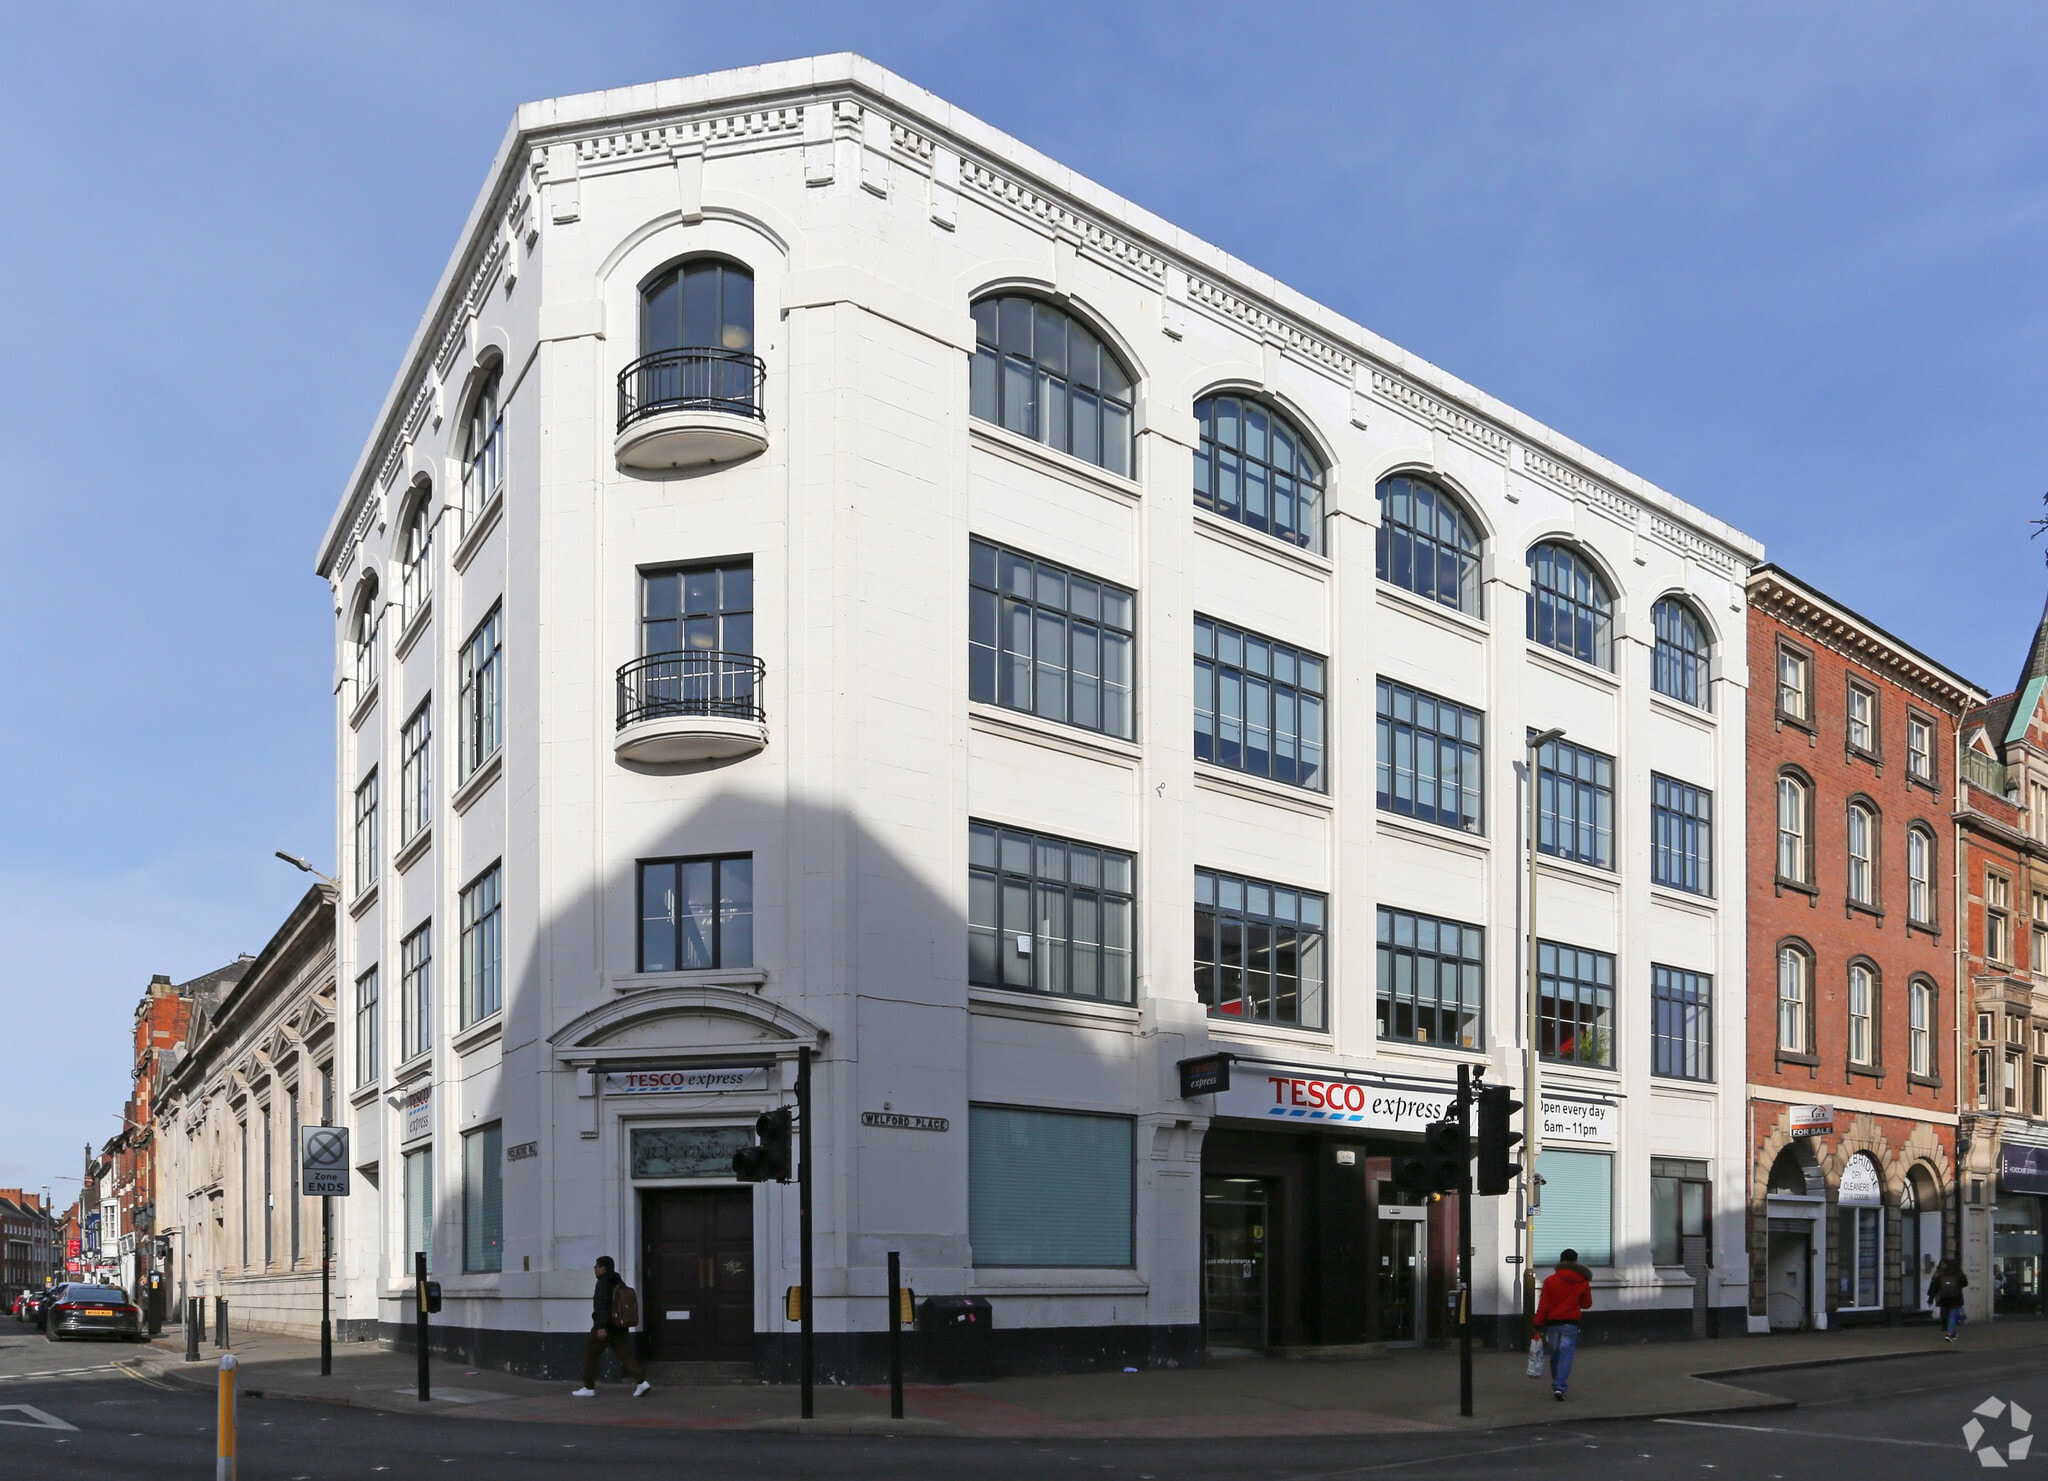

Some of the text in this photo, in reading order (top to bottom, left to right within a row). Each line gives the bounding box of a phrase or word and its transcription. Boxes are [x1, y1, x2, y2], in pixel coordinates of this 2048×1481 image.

[1189, 1061, 1218, 1075] TESCO
[626, 1072, 744, 1089] TESCO express
[1190, 1077, 1217, 1089] express
[408, 1086, 430, 1109] TESCO
[1268, 1076, 1441, 1122] TESCO express
[1562, 1104, 1587, 1118] every
[1589, 1103, 1606, 1120] day
[409, 1115, 429, 1135] express
[865, 1114, 946, 1130] WELFORD PLACE
[1544, 1119, 1564, 1133] 6am
[1572, 1122, 1597, 1138] 11pm
[1792, 1127, 1831, 1136] FOR SALE
[314, 1172, 338, 1181] Zone
[1851, 1170, 1862, 1180] DRY
[308, 1182, 345, 1192] ENDS
[1843, 1181, 1870, 1192] CLEANERS
